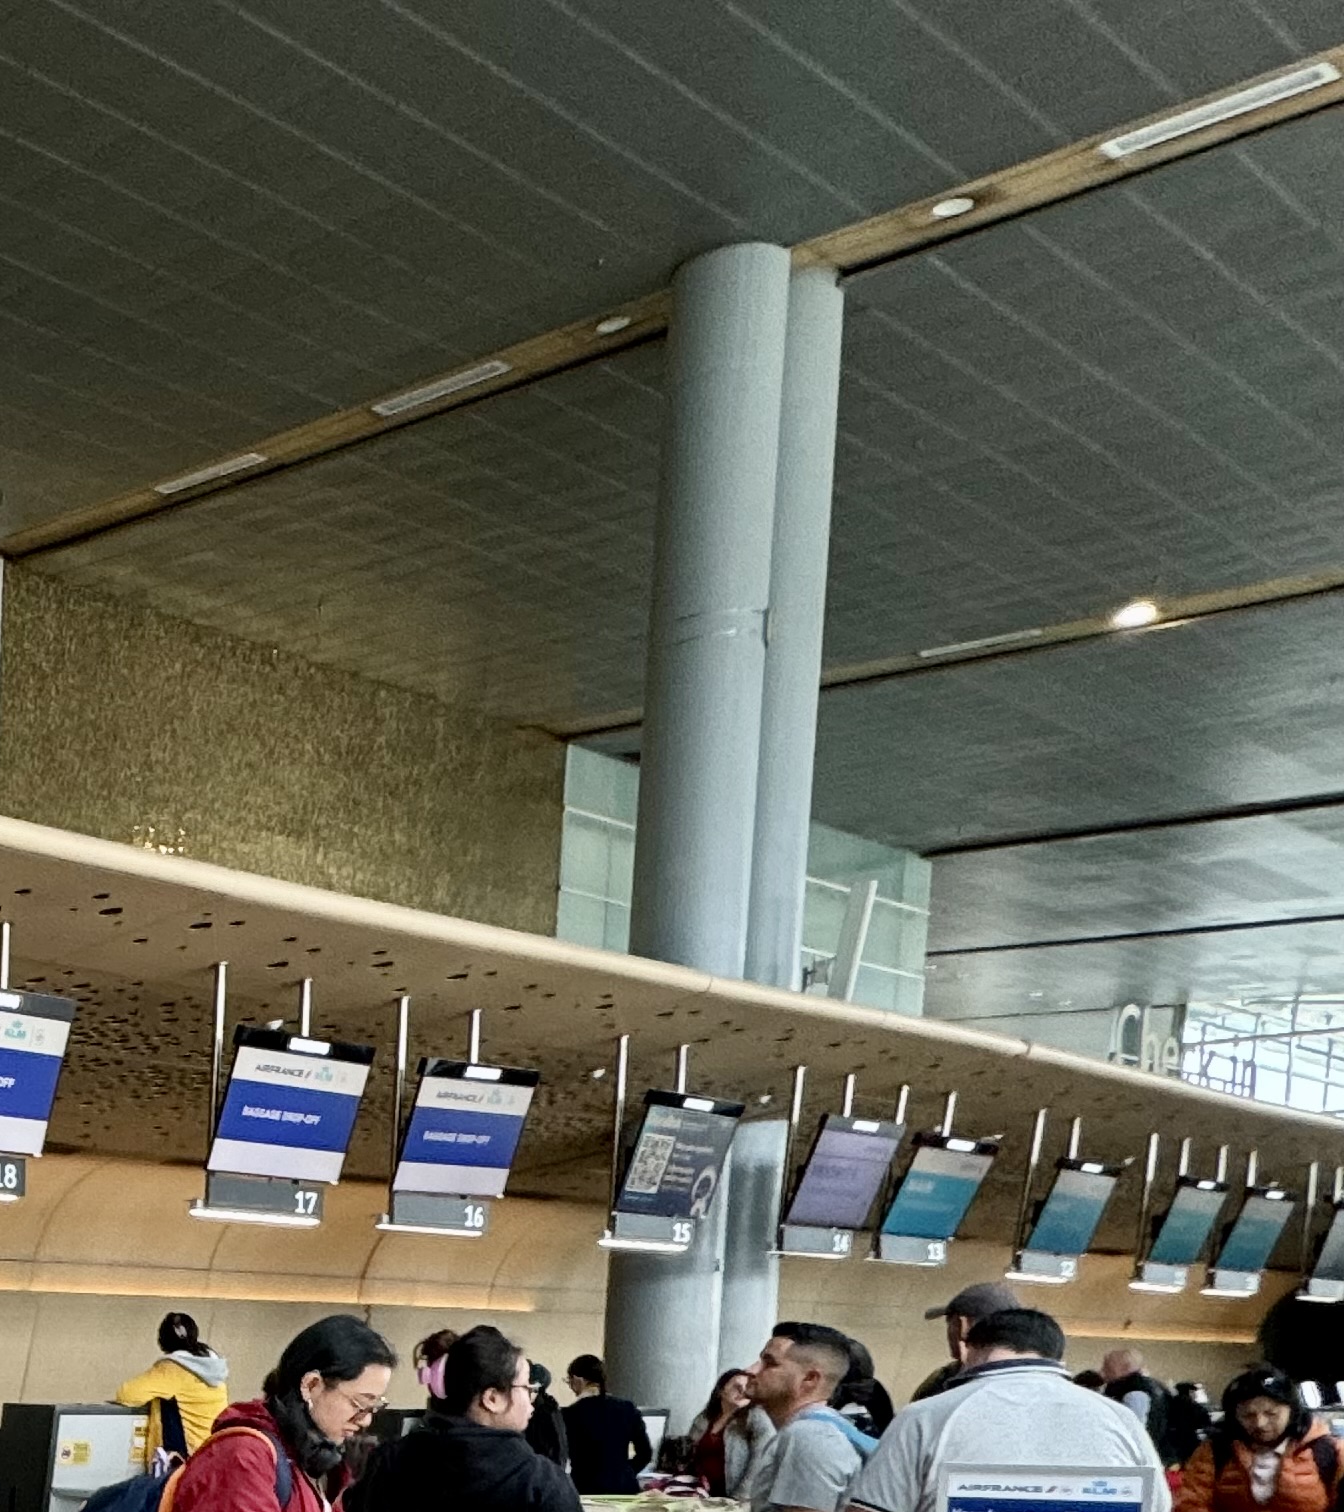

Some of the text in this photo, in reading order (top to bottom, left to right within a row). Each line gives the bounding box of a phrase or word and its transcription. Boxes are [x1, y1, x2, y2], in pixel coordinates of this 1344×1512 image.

[294, 1190, 318, 1215] 17
[464, 1204, 484, 1228] 16
[672, 1222, 692, 1243] 15
[927, 1242, 945, 1260] 13
